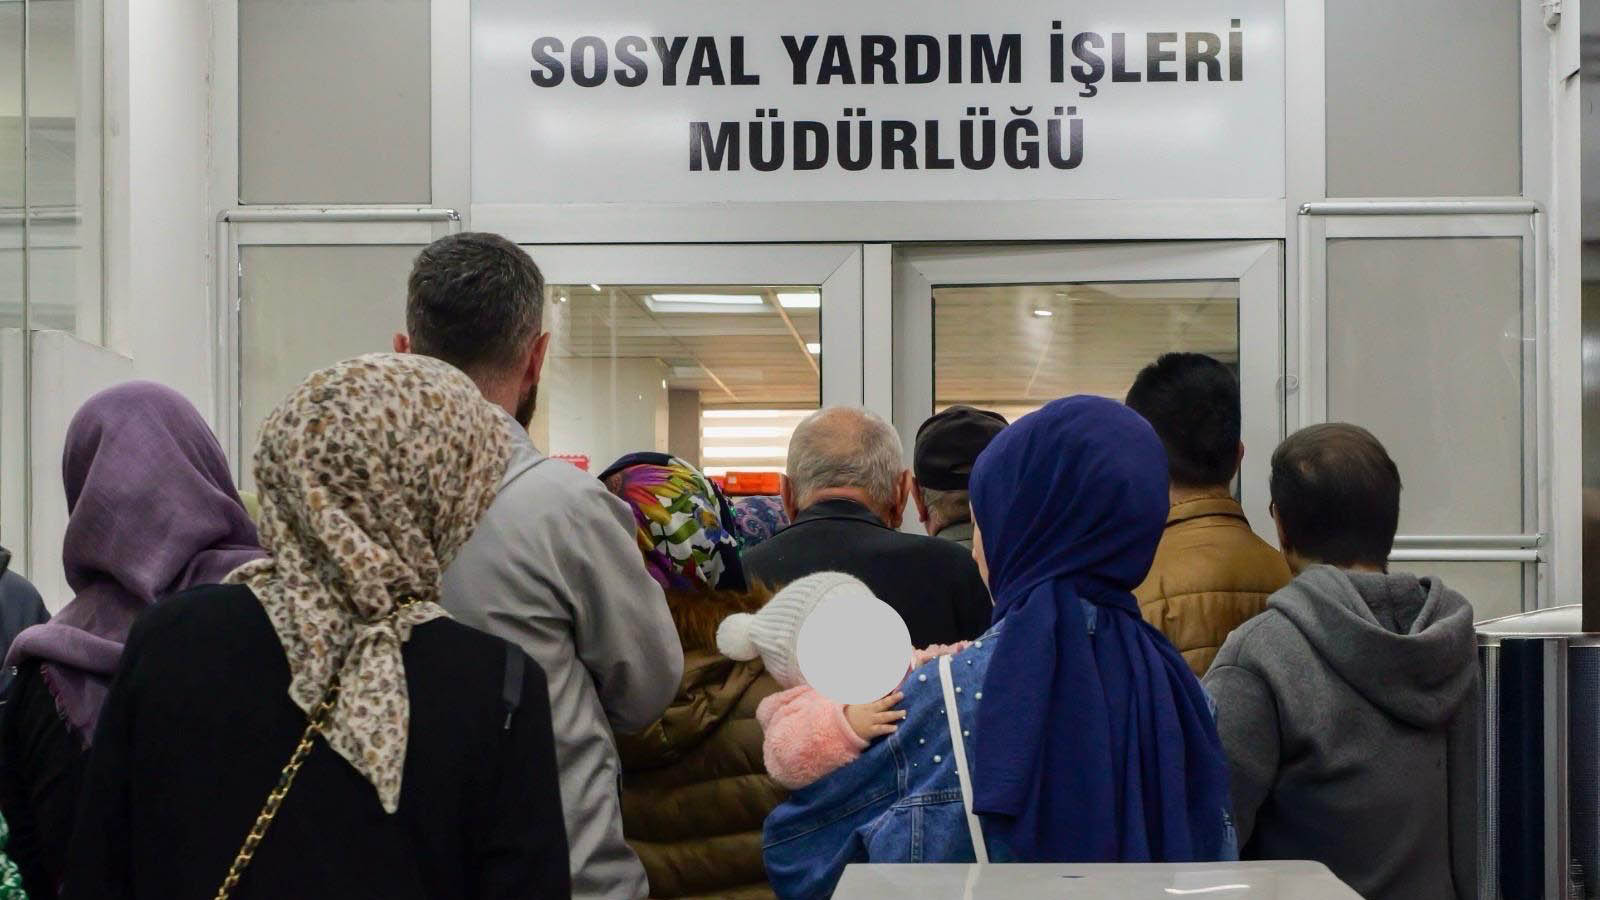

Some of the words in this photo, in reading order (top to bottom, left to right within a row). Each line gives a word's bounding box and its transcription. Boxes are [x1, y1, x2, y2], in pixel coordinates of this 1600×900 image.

[530, 35, 760, 88] SOSYAL
[781, 33, 1022, 86] YARDIM
[1050, 19, 1244, 98] İŞLERİ
[689, 106, 1084, 172] MÜDÜRLÜĞÜ
